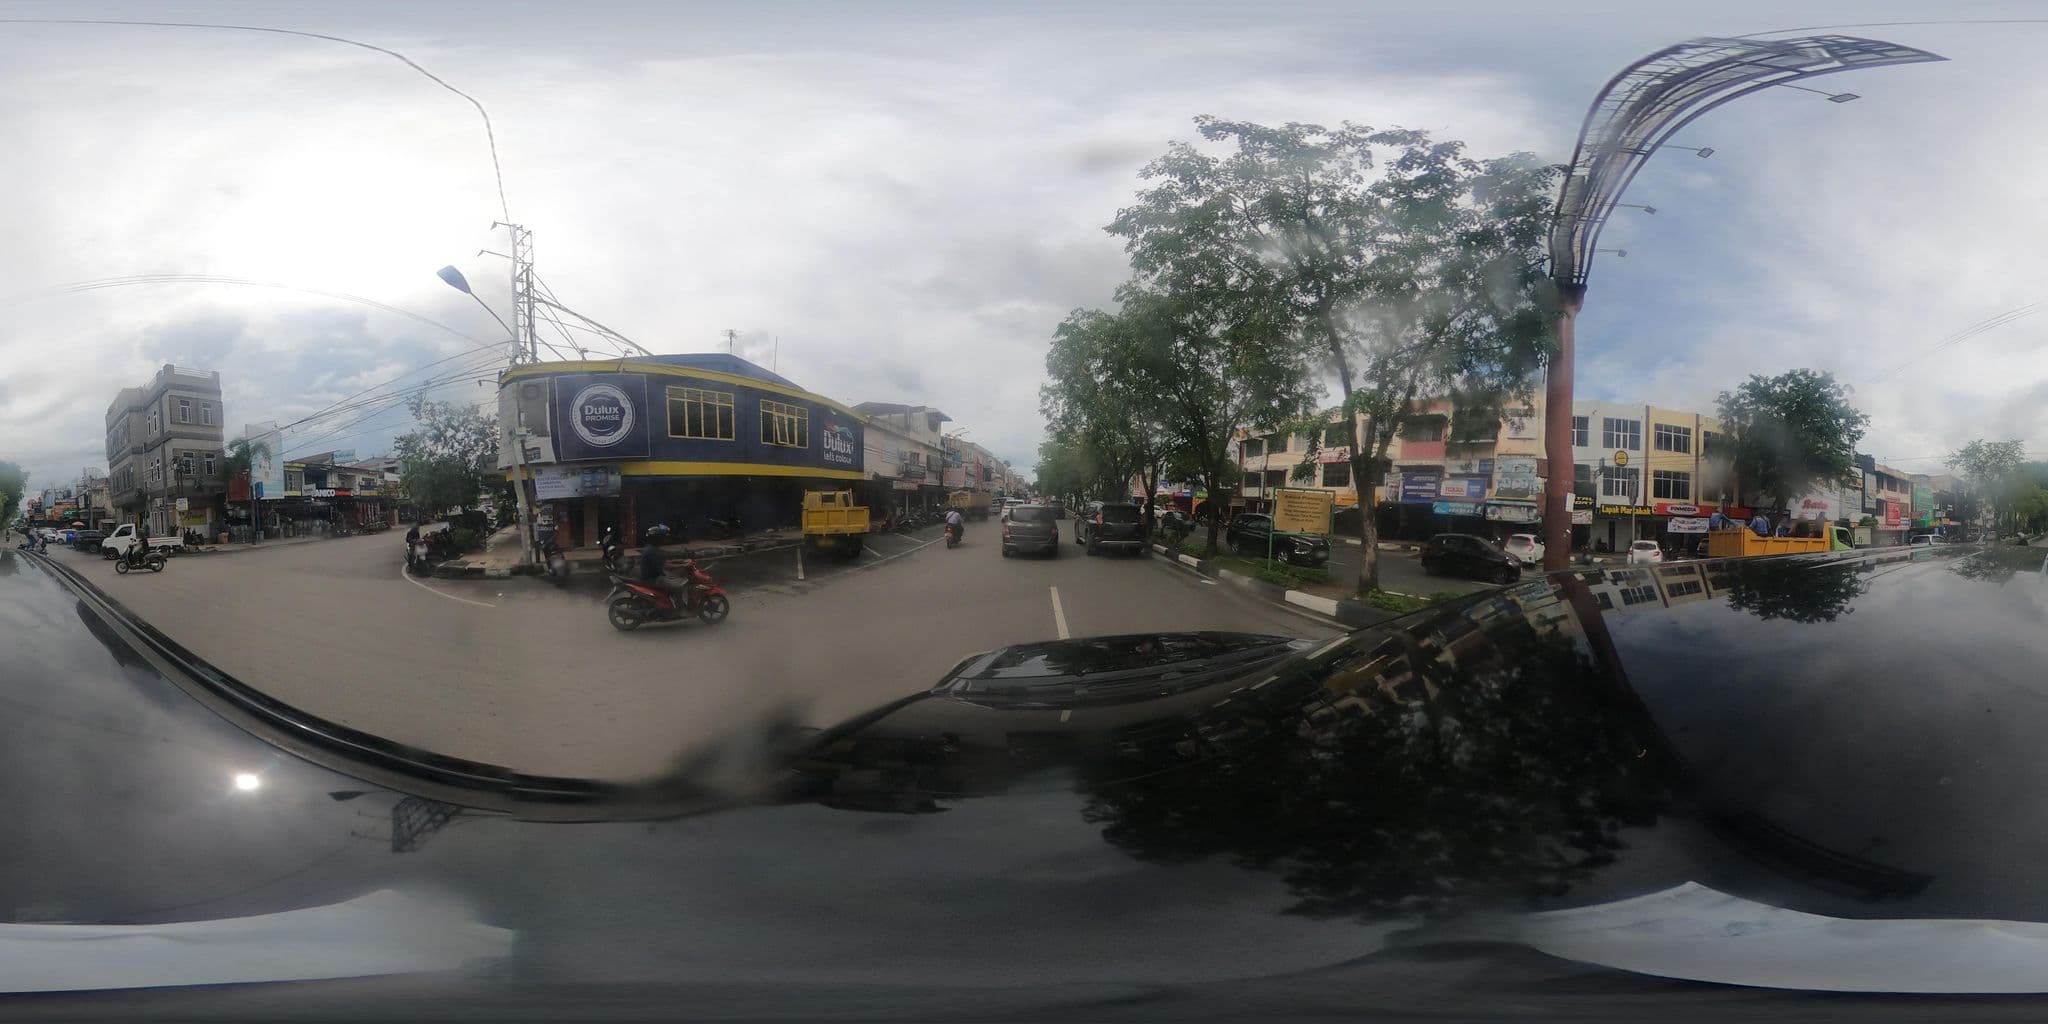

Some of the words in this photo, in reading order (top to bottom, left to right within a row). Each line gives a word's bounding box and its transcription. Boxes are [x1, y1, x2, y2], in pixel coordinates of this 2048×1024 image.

[584, 405, 619, 415] Dulux
[824, 430, 852, 454] Dulux
[835, 453, 852, 464] colour
